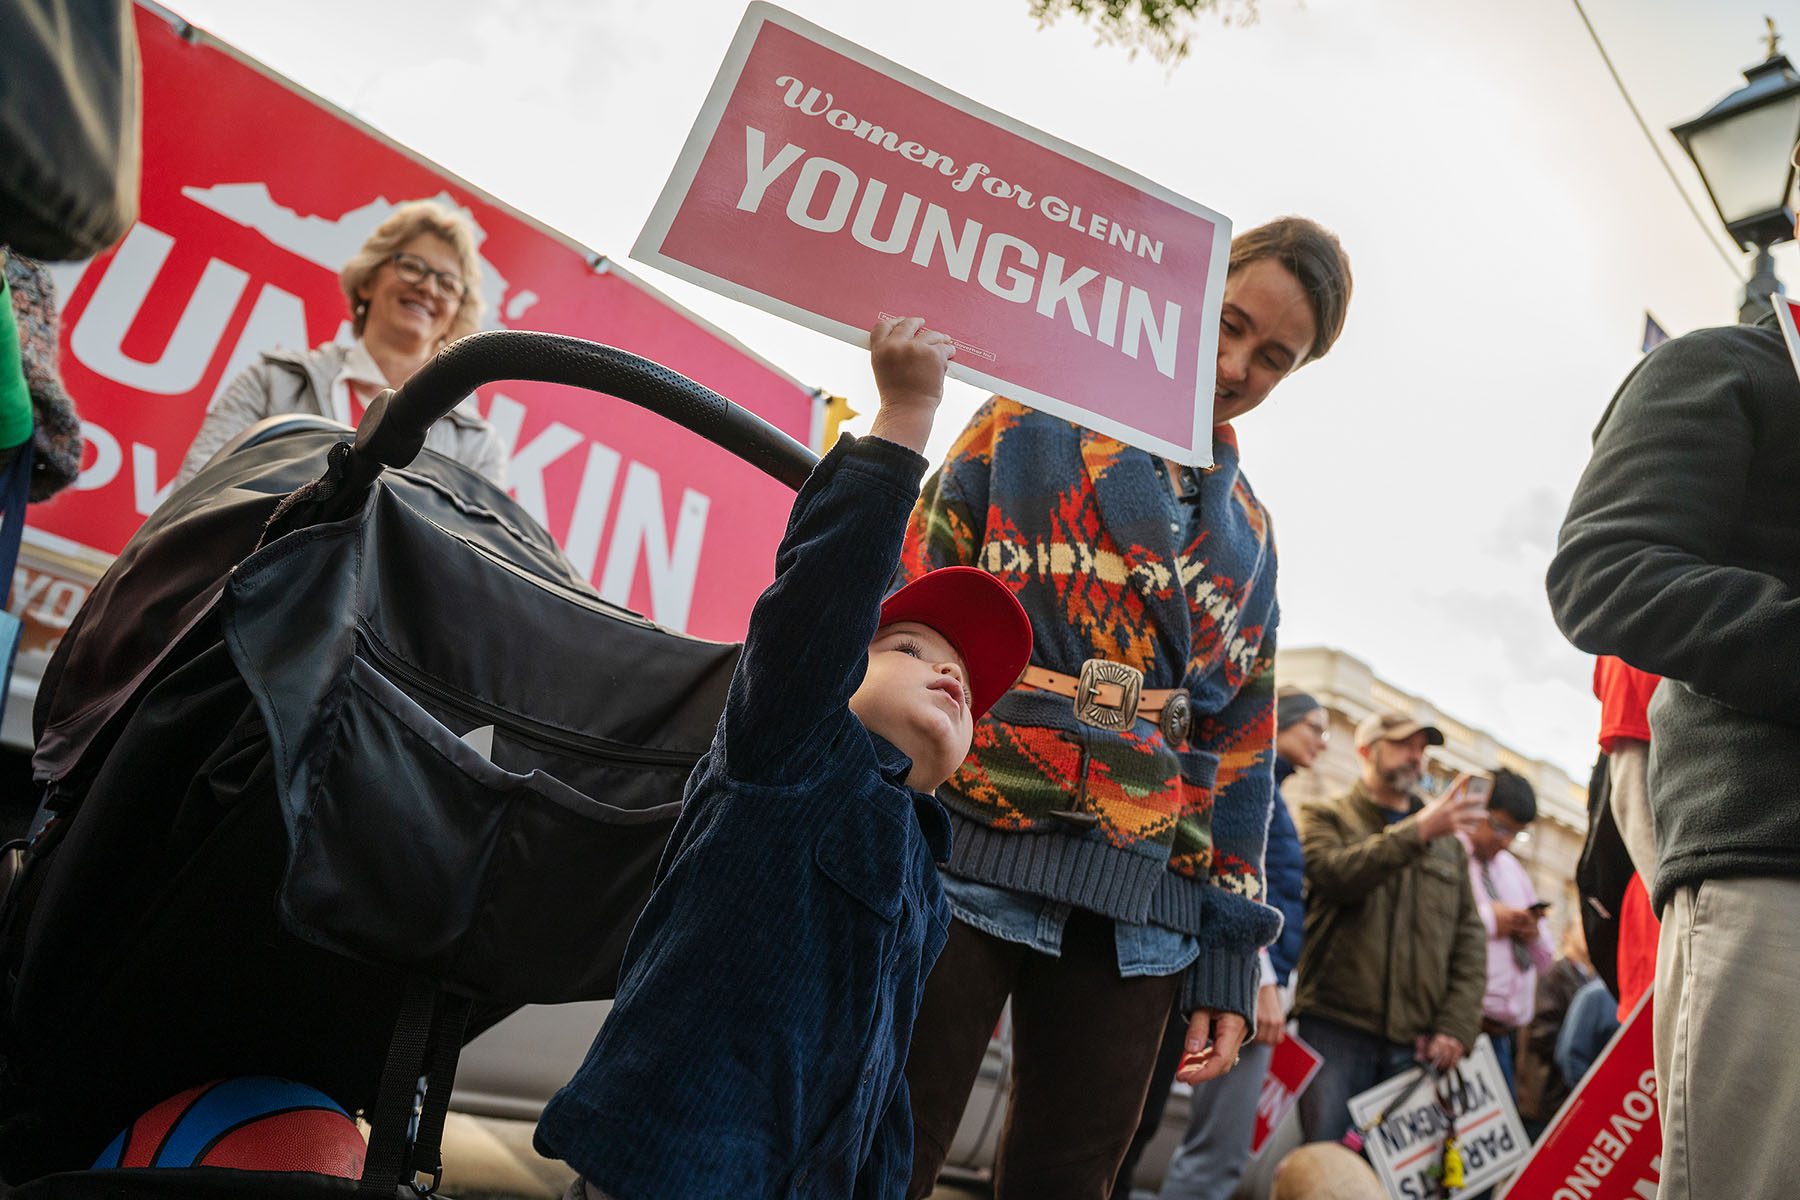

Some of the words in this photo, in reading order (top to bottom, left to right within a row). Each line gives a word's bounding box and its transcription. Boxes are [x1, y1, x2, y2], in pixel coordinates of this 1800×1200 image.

[775, 75, 958, 177] Women
[951, 162, 1036, 210] for
[1040, 195, 1164, 265] GLENN
[735, 125, 1182, 379] YOUNGKIN
[1379, 1071, 1496, 1156] YONGKIN
[1400, 1122, 1514, 1200] PARTS
